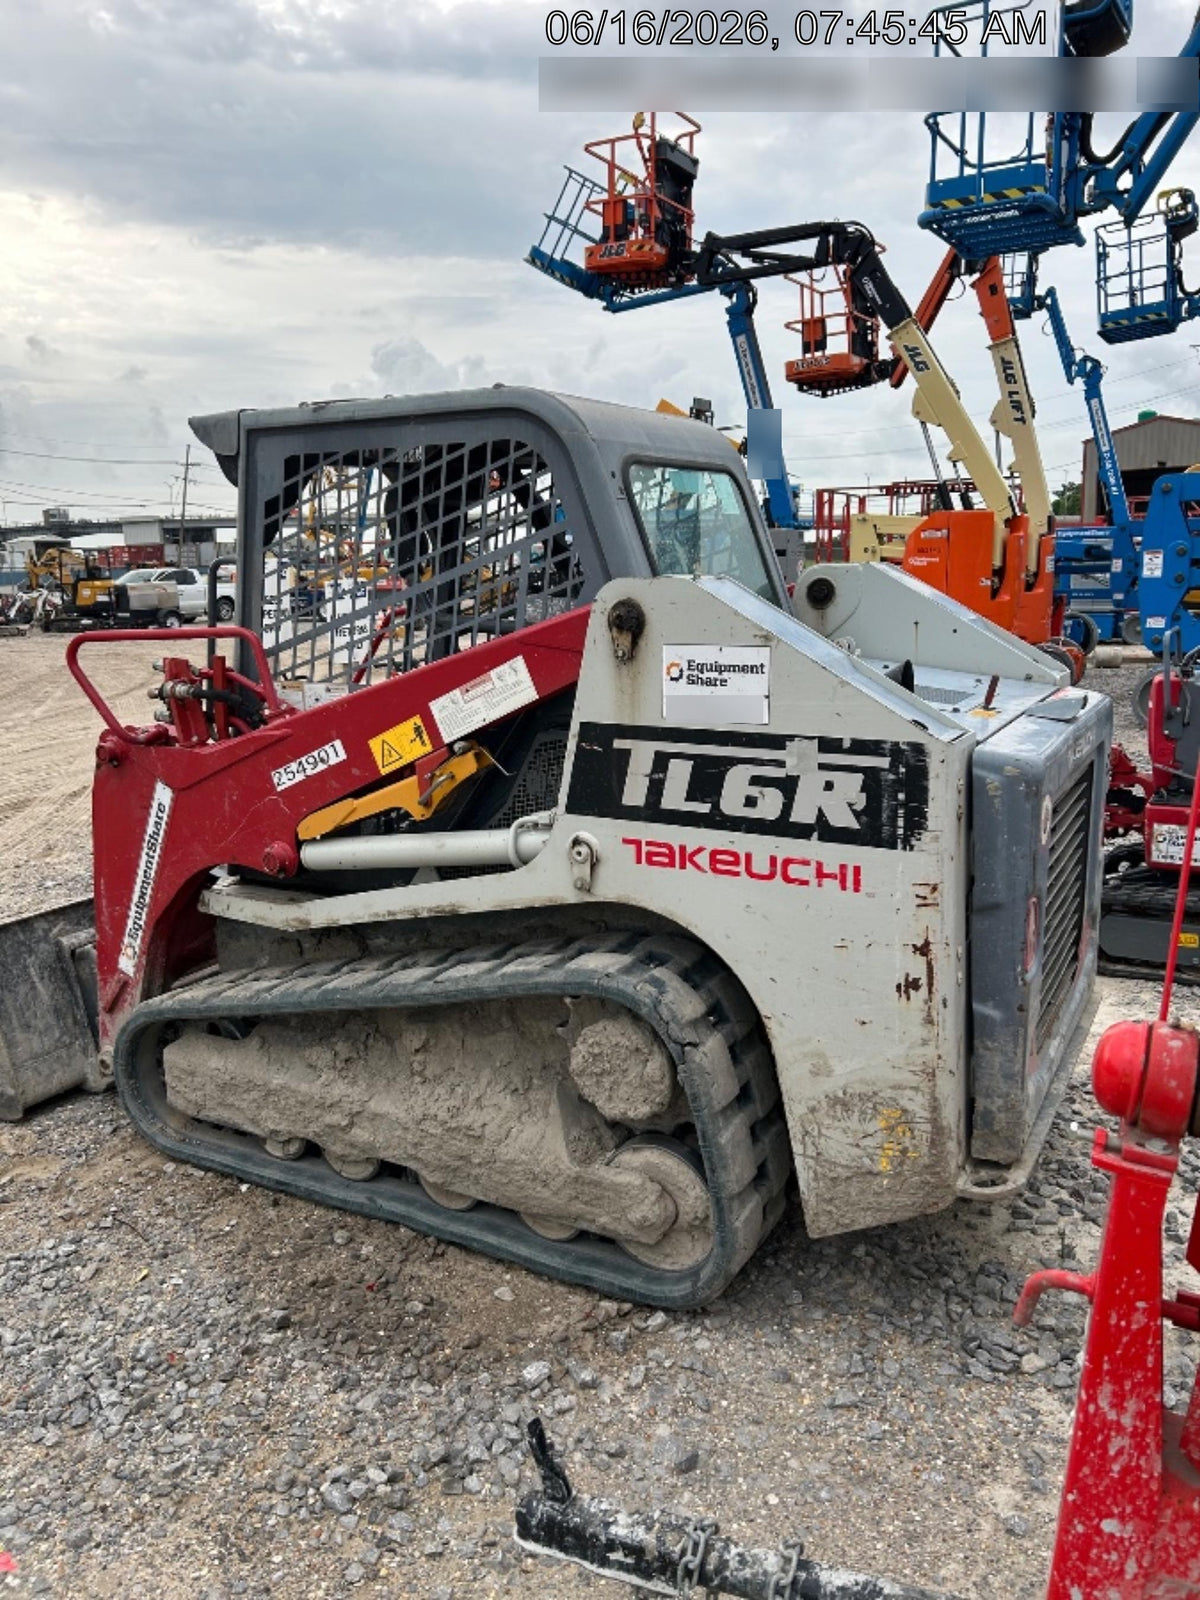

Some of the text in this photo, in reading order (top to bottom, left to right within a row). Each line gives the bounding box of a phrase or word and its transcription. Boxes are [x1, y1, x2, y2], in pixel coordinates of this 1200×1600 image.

[599, 244, 626, 259] JLG
[903, 344, 930, 372] JLG
[1000, 356, 1026, 425] JLG LIFT
[686, 674, 729, 688] Share
[687, 659, 766, 676] Equipment
[273, 743, 340, 787] 254901
[613, 737, 891, 830] TL6R
[127, 802, 167, 943] EquipmentShare
